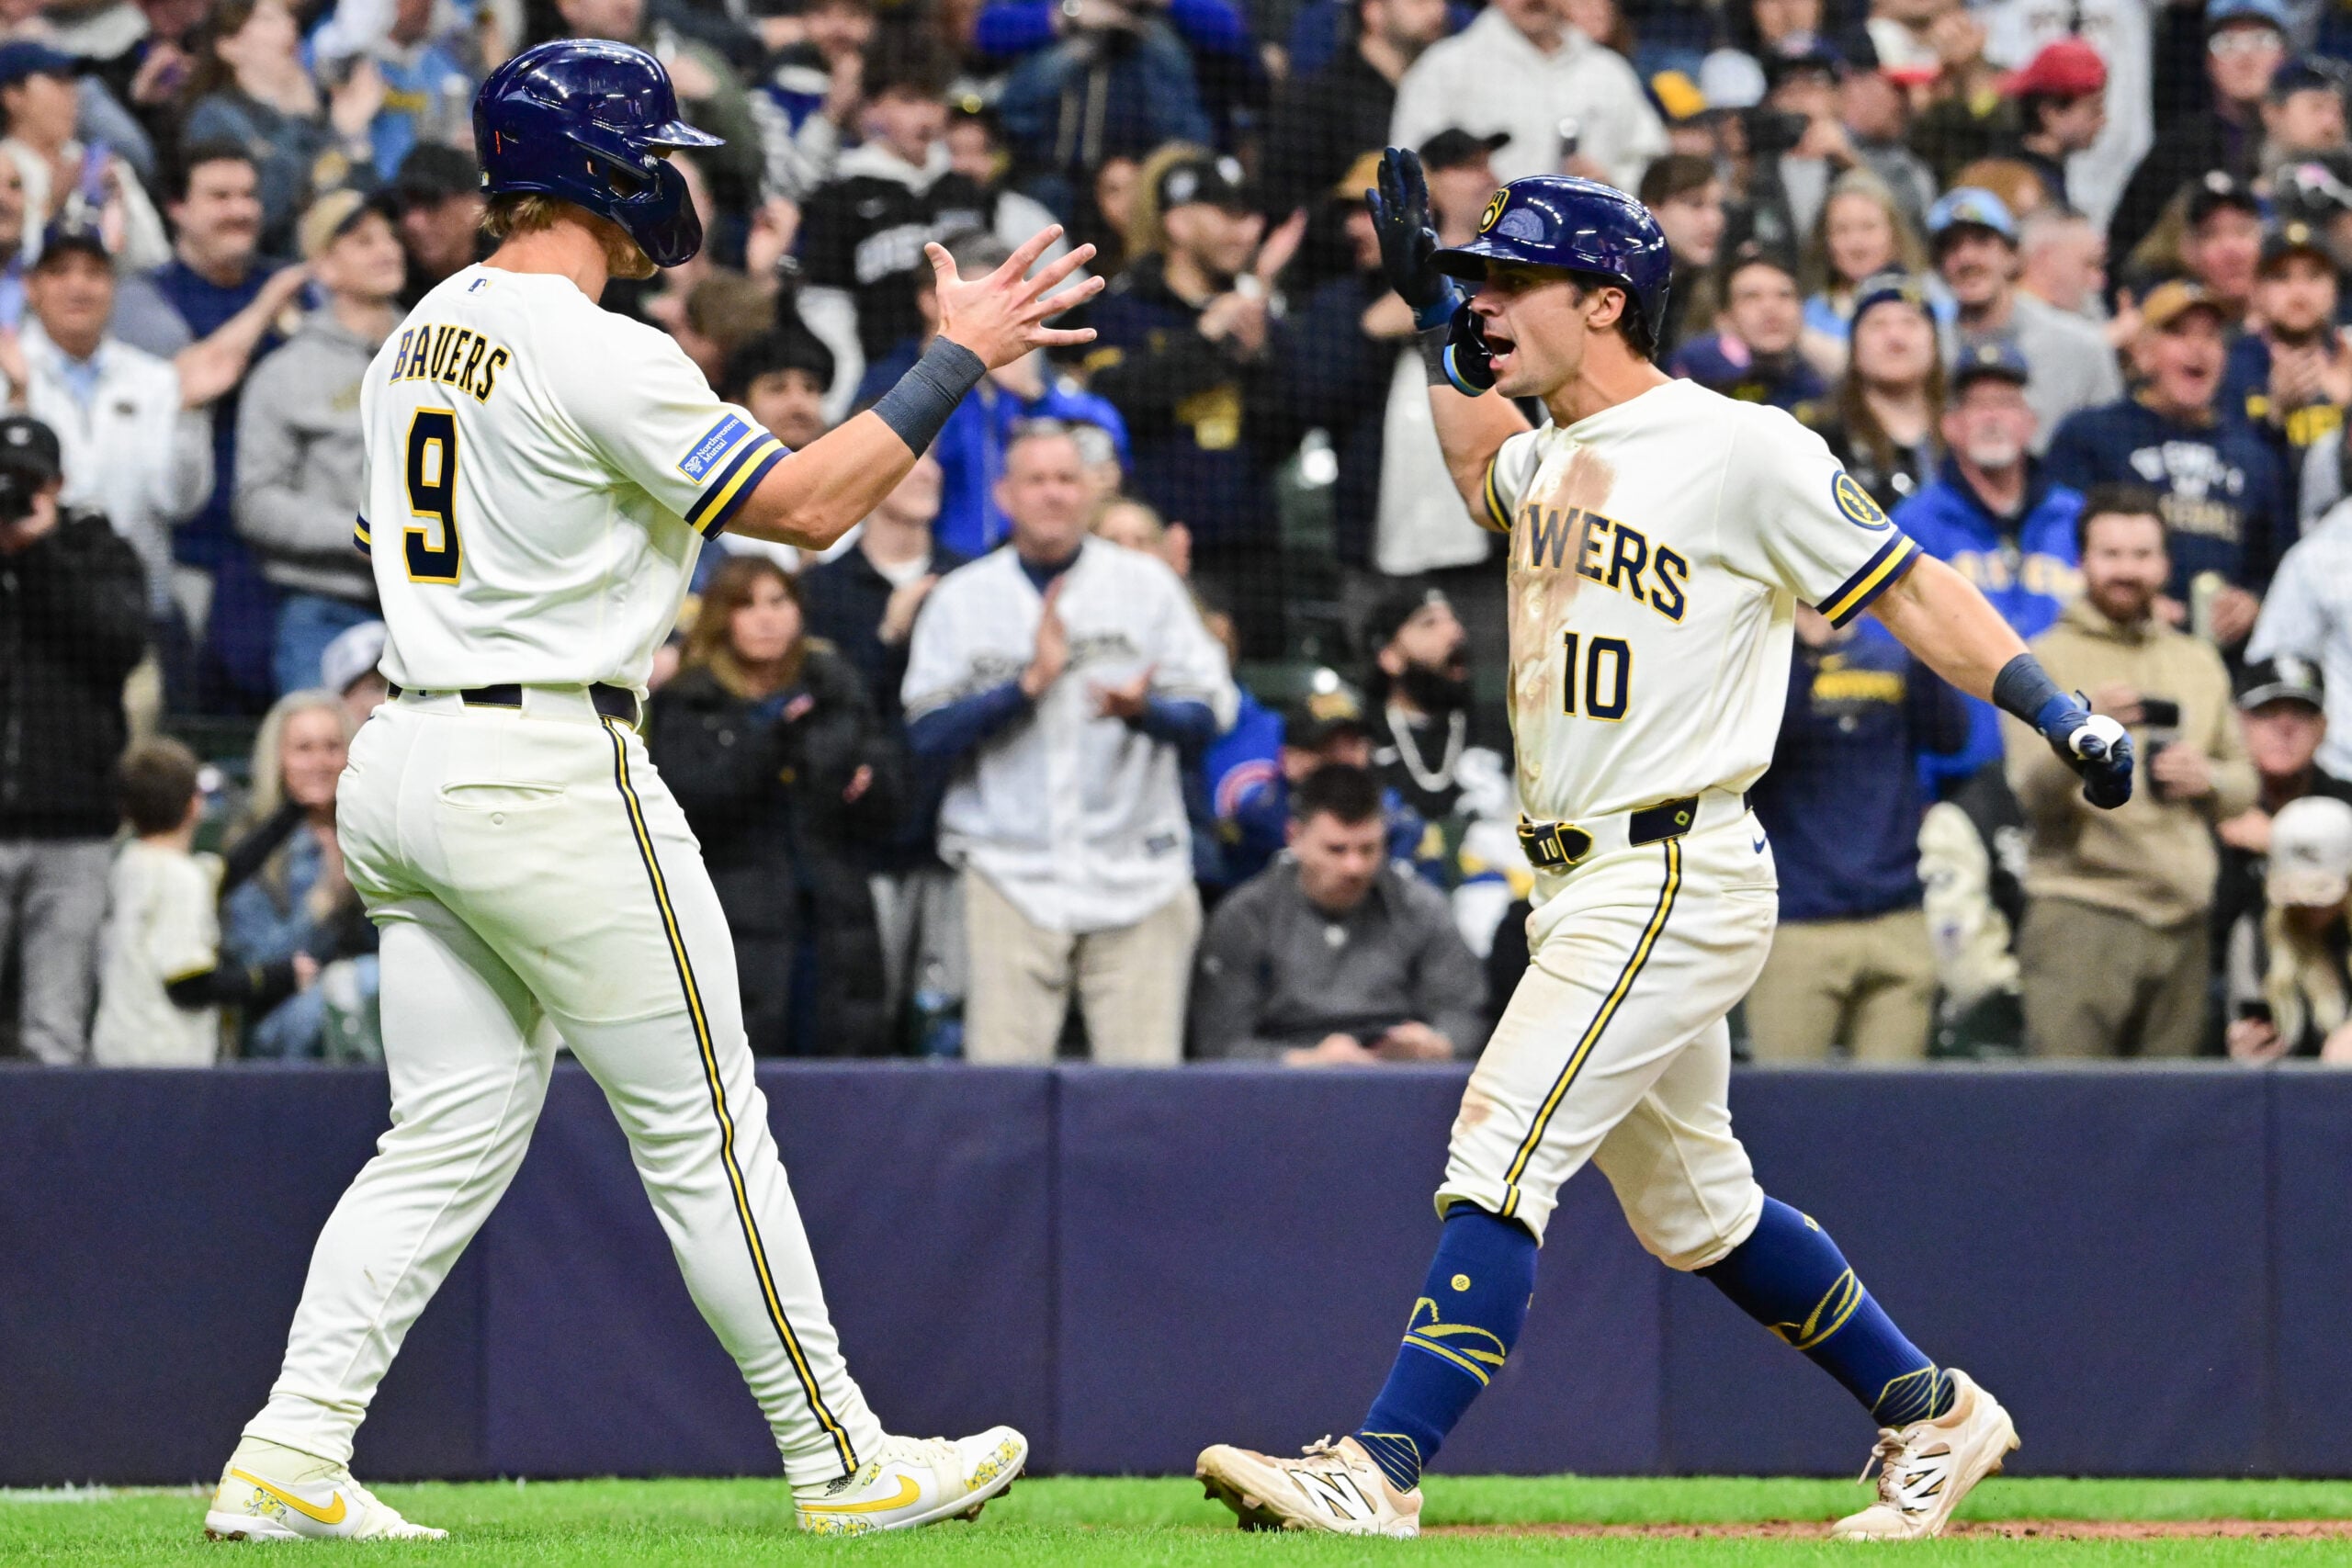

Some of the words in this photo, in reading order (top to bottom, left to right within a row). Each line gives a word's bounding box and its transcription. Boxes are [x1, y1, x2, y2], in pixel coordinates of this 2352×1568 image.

[389, 323, 511, 405] BAUERS
[696, 418, 740, 457] Northwestern
[702, 438, 728, 464] Mutual
[402, 406, 463, 584] 9
[1512, 502, 1690, 625] WERS
[1563, 630, 1634, 724] 10
[1538, 837, 1560, 861] 10
